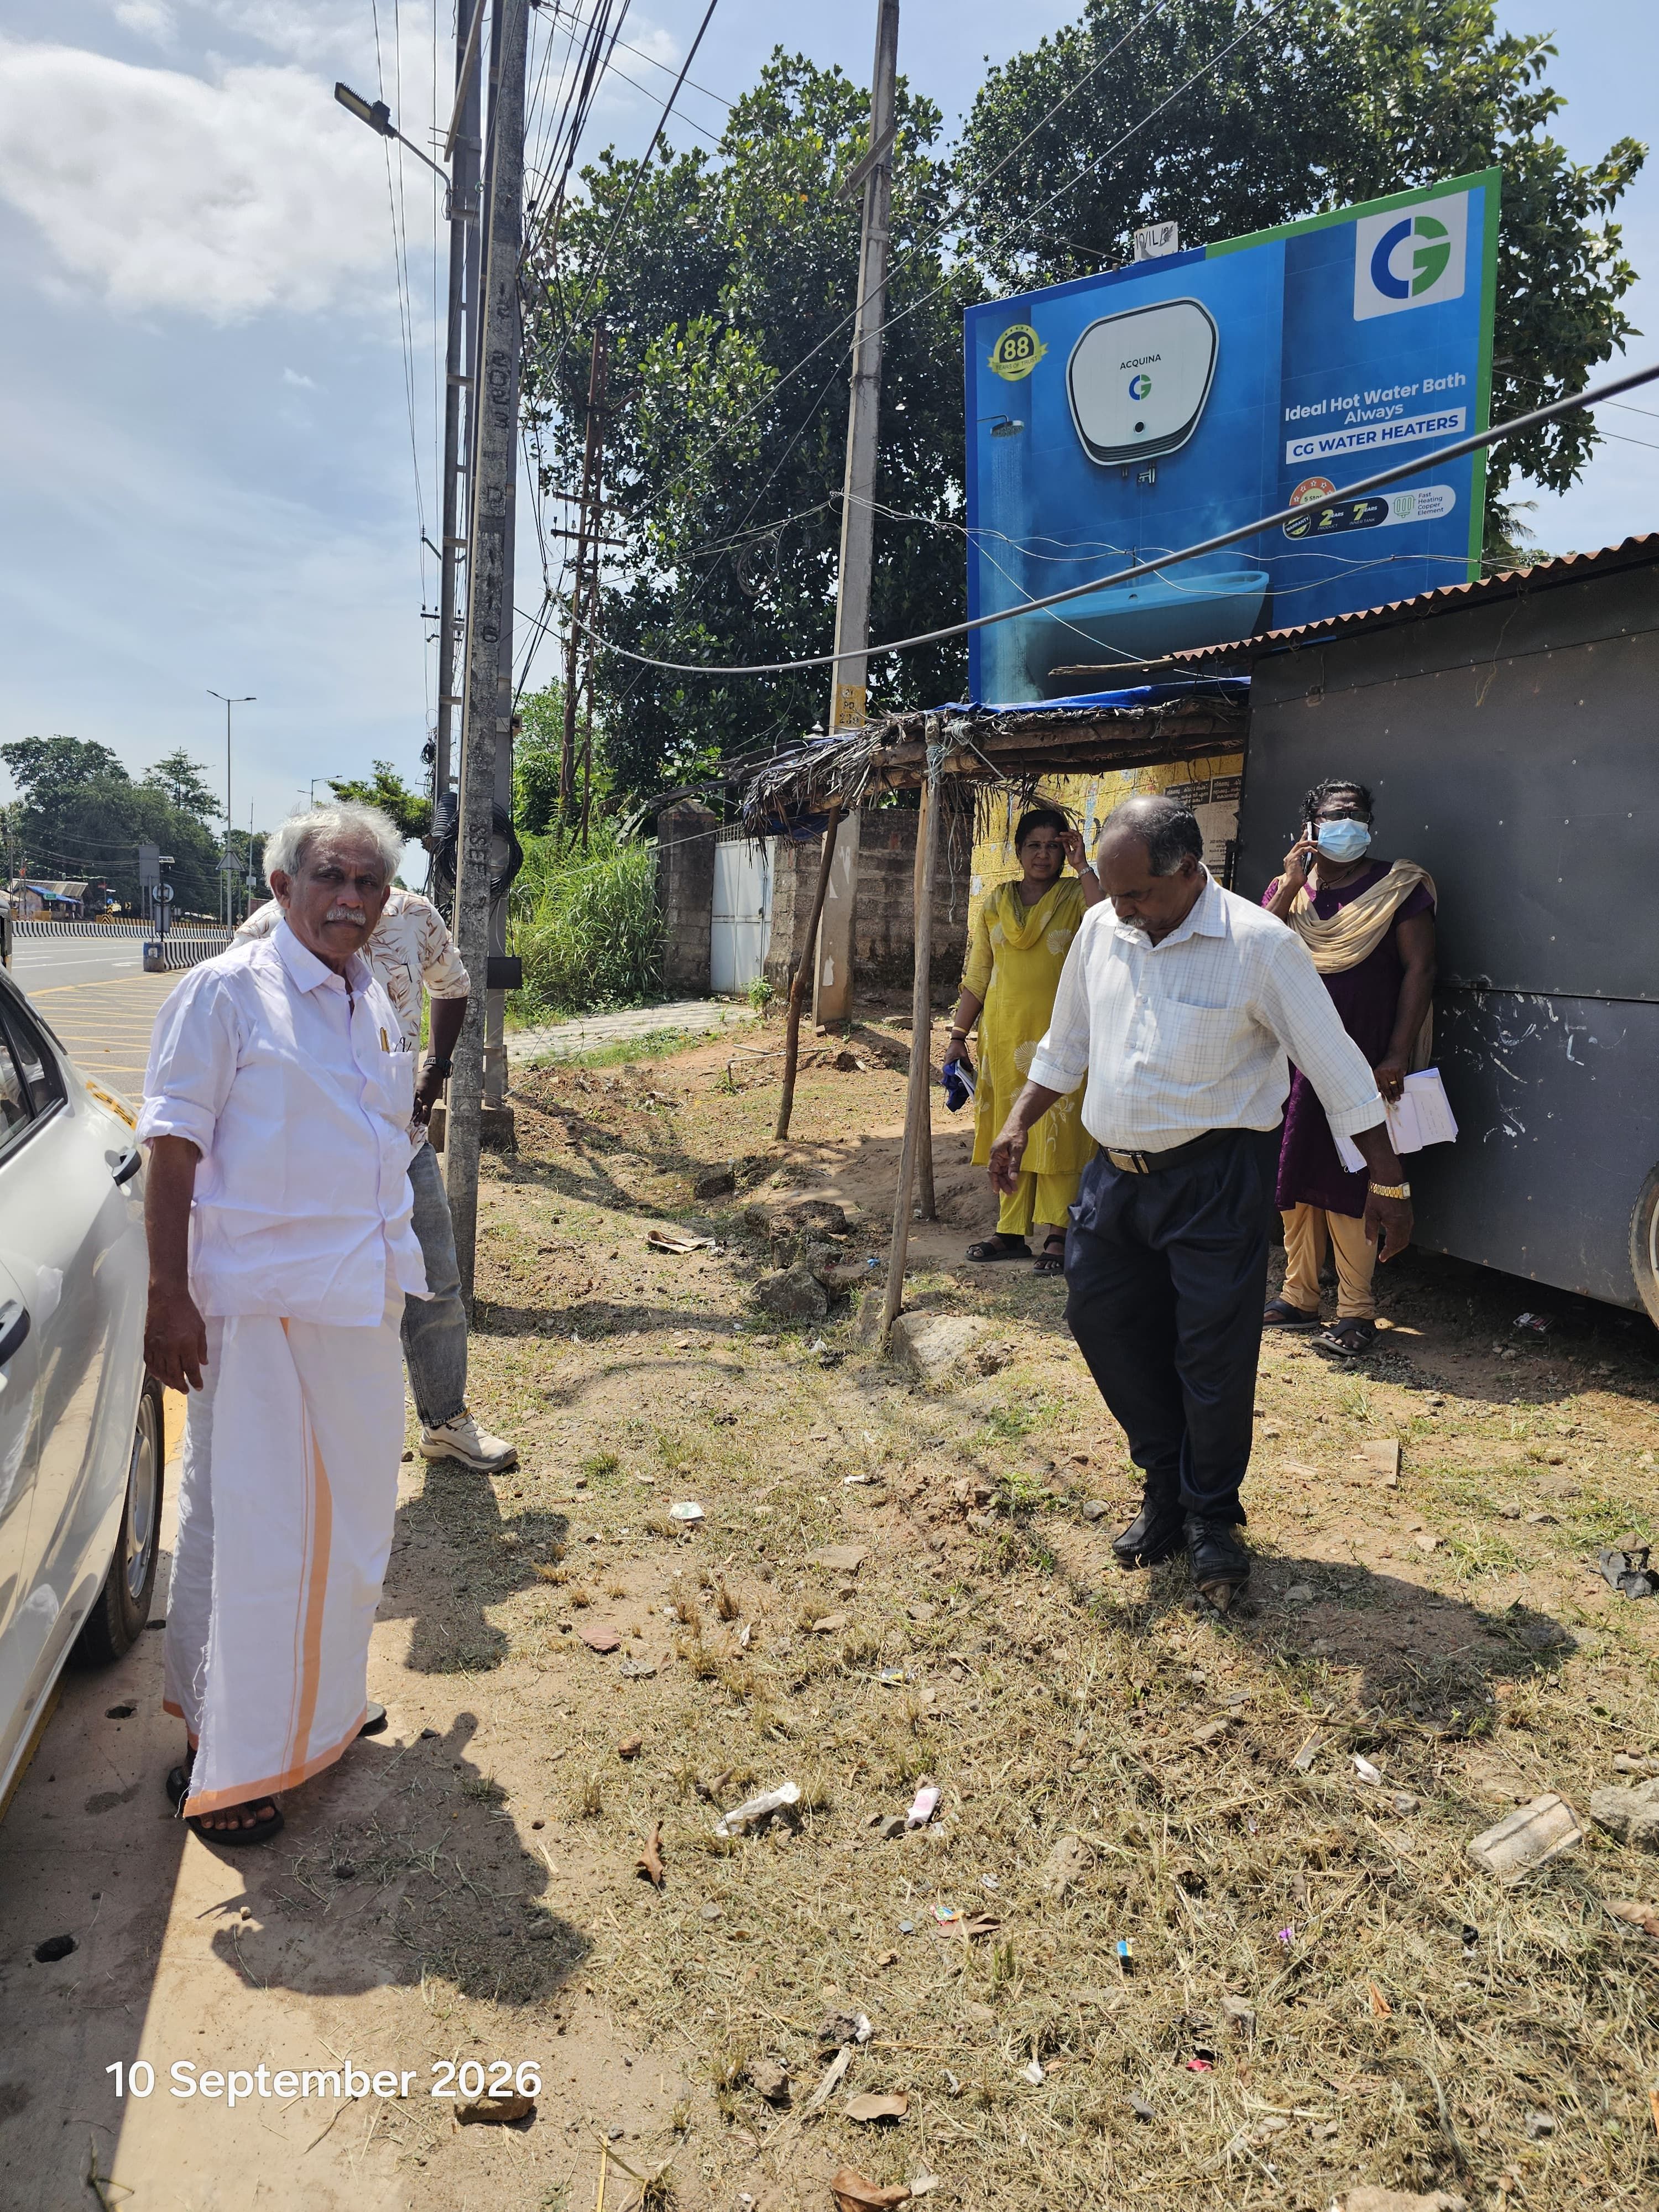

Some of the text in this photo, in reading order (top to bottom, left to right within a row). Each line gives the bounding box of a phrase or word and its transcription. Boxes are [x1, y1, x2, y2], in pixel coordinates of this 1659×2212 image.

[1004, 336, 1029, 360] 88
[1022, 356, 1037, 365] TRUST
[1120, 354, 1161, 370] ACQUINA
[1285, 372, 1465, 421] Ideal Hot Water Bath
[1344, 404, 1404, 425] Always
[1293, 415, 1459, 457] CG WATER HEATERS
[1418, 496, 1443, 504] Heating
[1319, 509, 1334, 526] 2
[1353, 503, 1368, 521] 7
[1417, 507, 1444, 515] Element
[1286, 516, 1309, 532] WARRANTY
